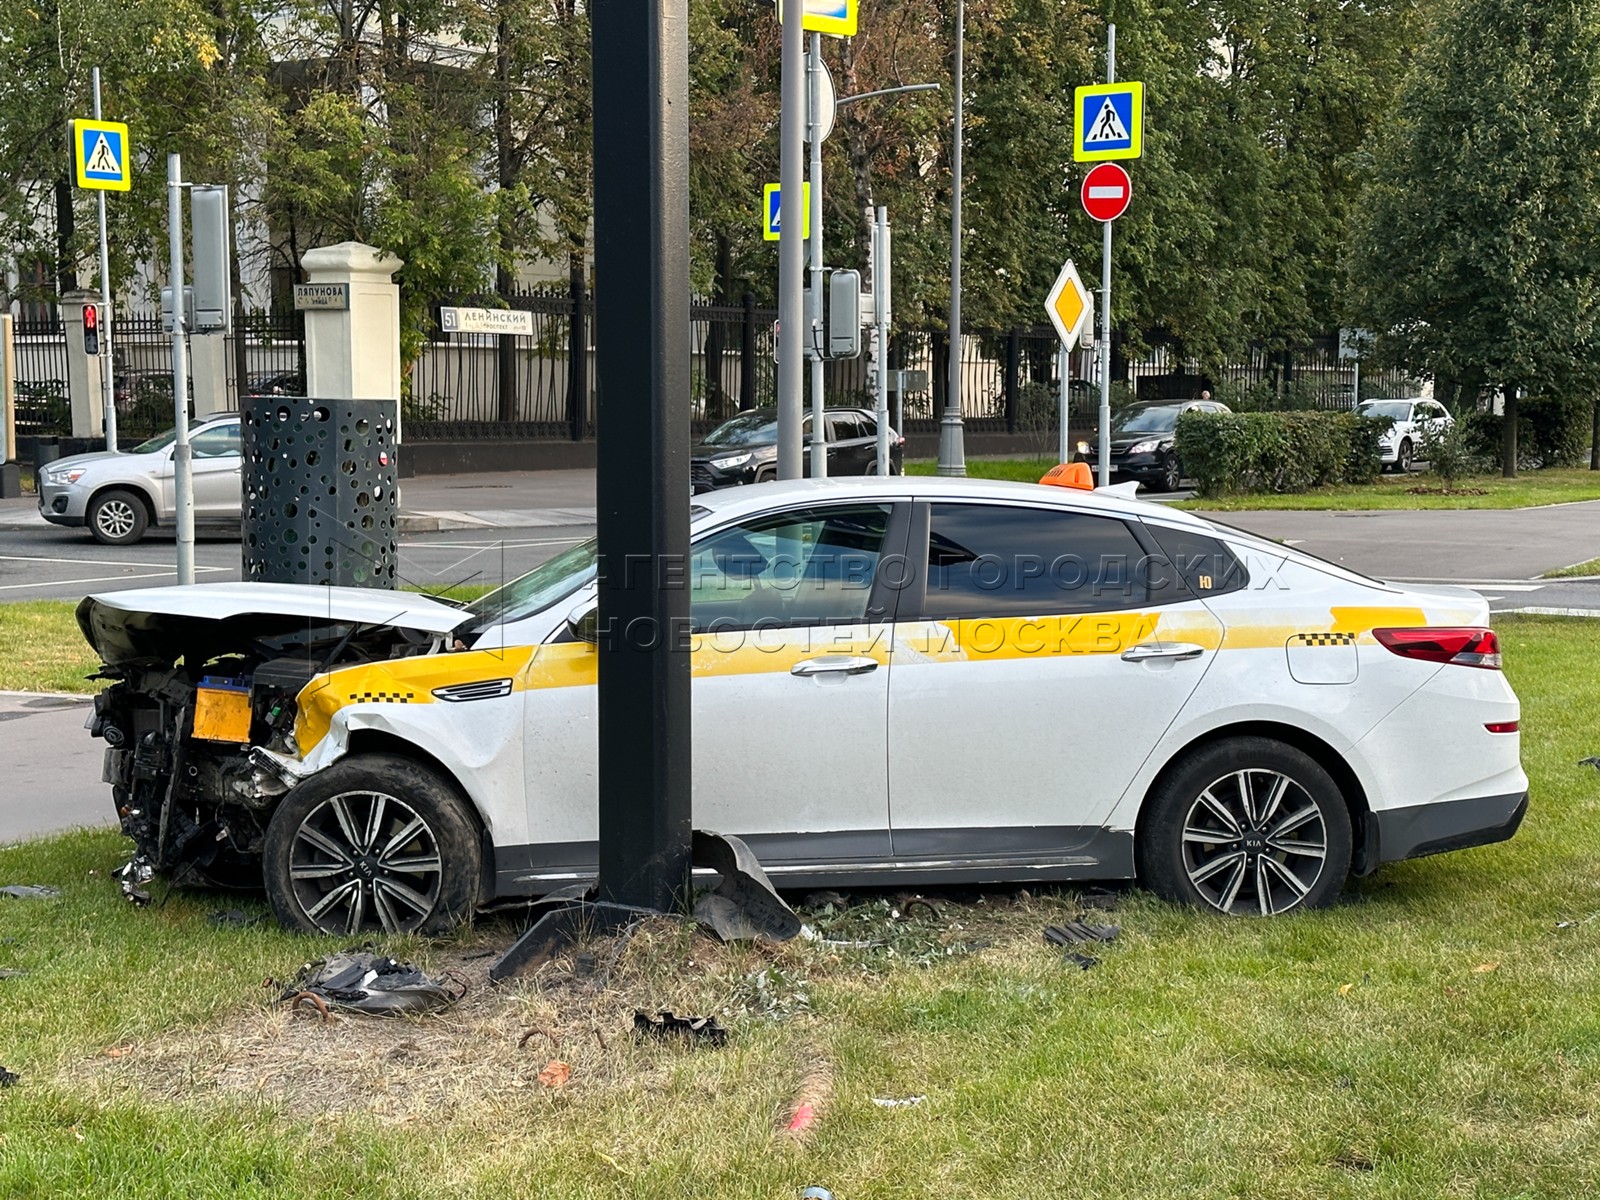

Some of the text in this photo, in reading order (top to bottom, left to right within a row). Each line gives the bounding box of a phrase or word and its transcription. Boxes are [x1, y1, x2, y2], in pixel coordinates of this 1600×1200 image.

[297, 287, 343, 296] ЛЯПУНОВА
[445, 312, 456, 327] 51
[464, 312, 526, 323] ЛЕНИНСКИЙ
[359, 861, 372, 876] KIA
